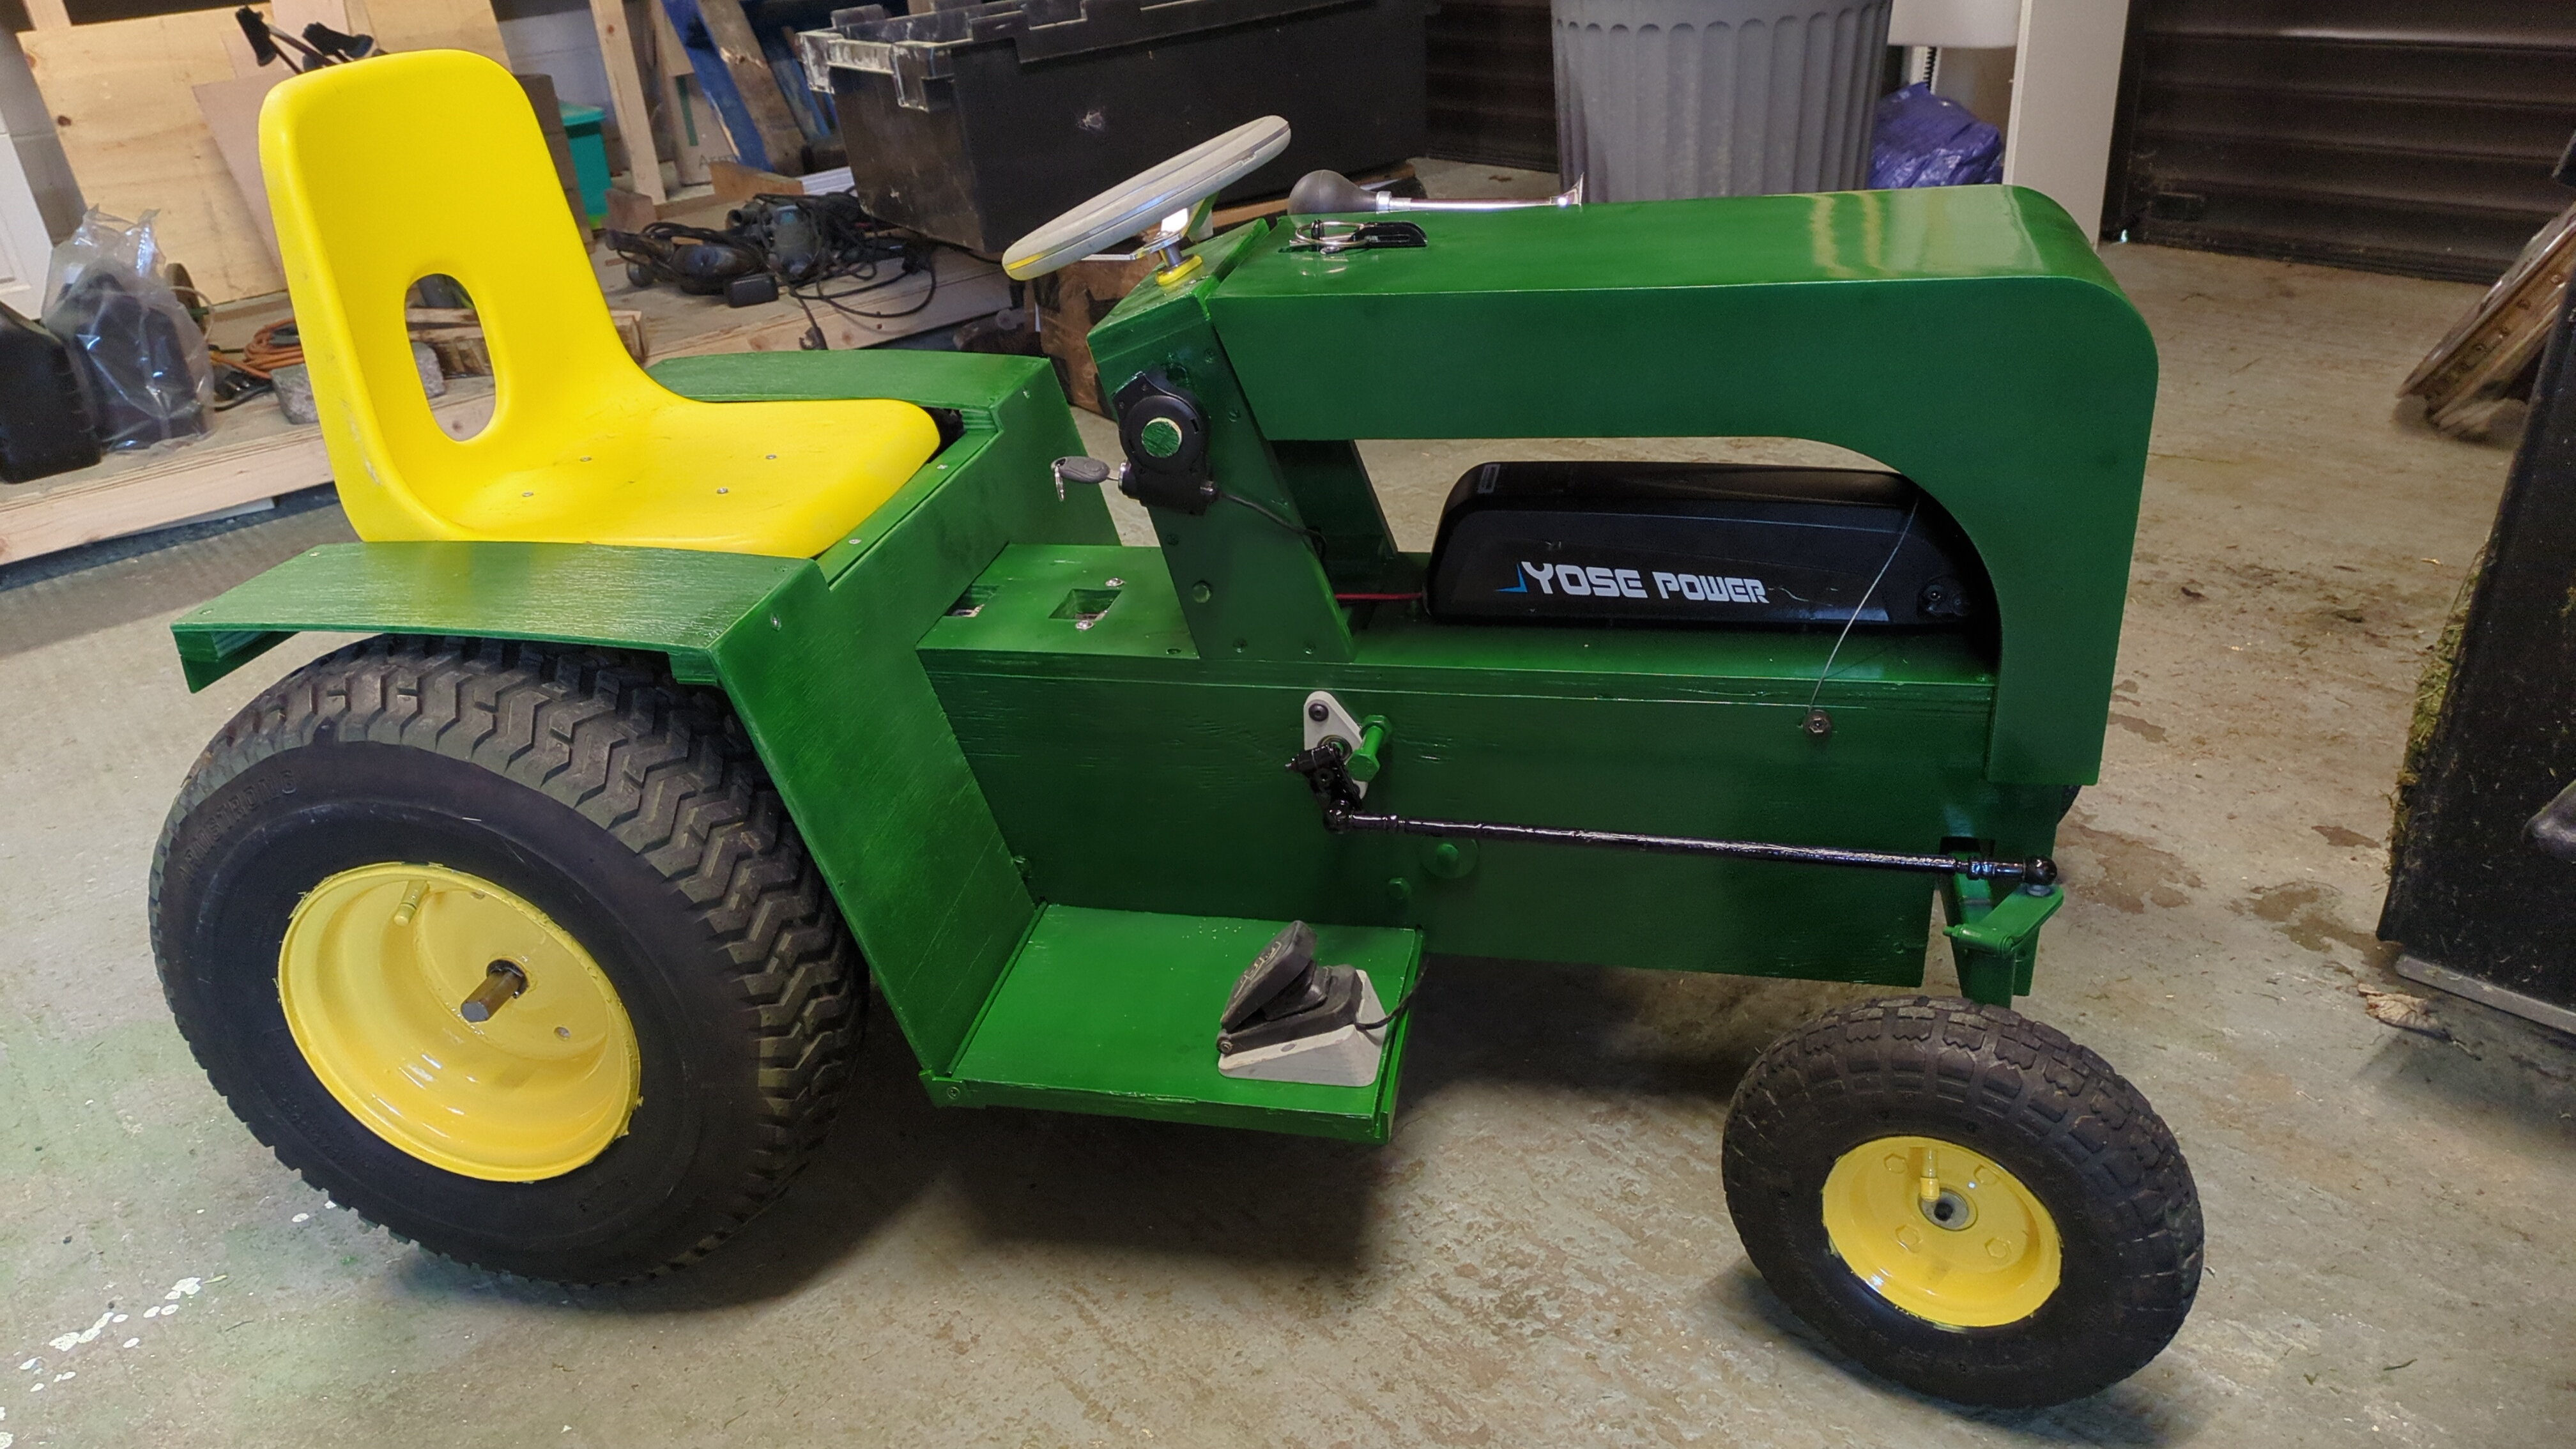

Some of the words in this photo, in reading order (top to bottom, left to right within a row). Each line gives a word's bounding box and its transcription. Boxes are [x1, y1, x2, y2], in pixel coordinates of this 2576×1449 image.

[1521, 561, 1648, 599] YOSE
[1652, 571, 1770, 604] POWER
[178, 769, 298, 889] ARMSTRONG
